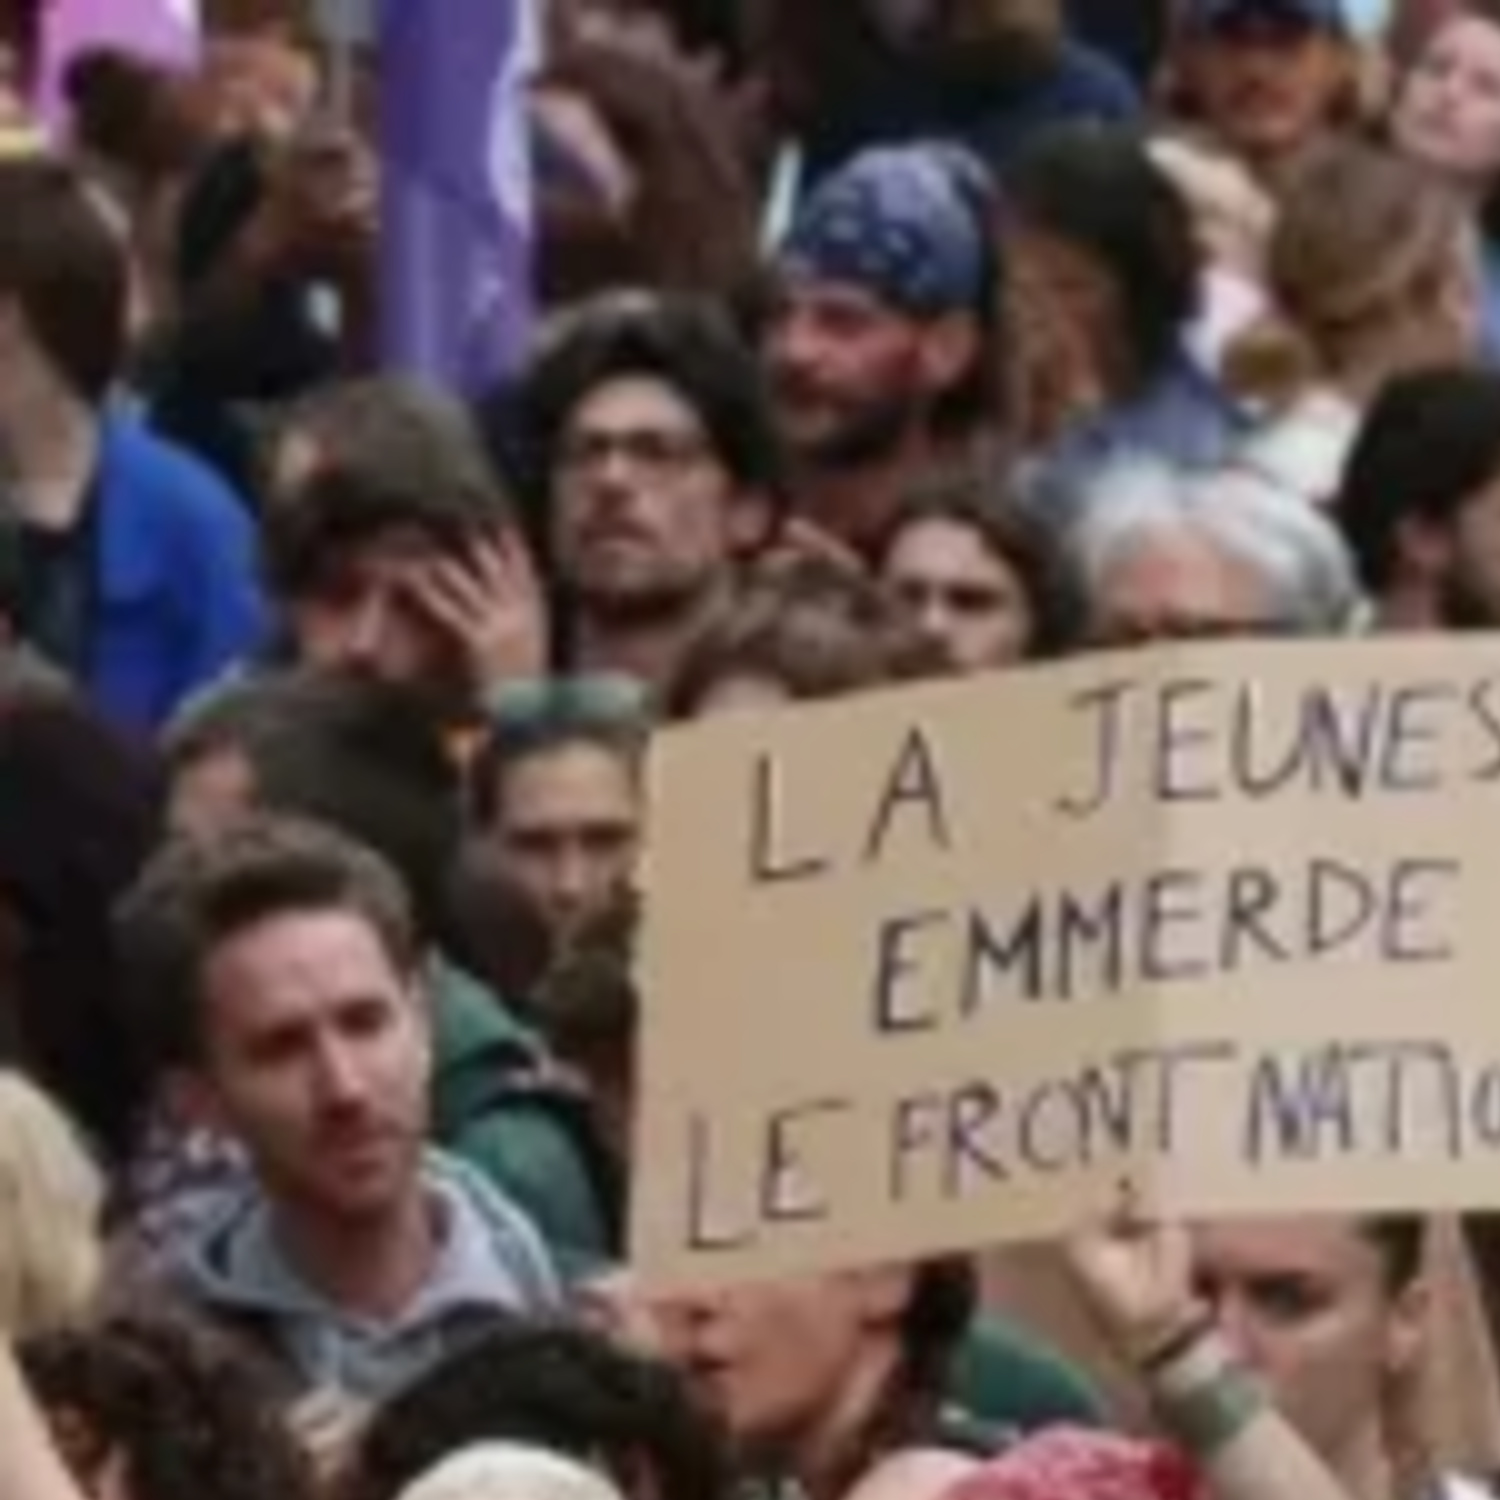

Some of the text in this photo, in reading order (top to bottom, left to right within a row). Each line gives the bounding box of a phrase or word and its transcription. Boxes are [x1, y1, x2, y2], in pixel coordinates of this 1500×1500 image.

[747, 725, 950, 885] LA
[873, 858, 1462, 1036] EMMERDE
[685, 1100, 850, 1252] LE
[890, 1040, 1238, 1202] FRONT
